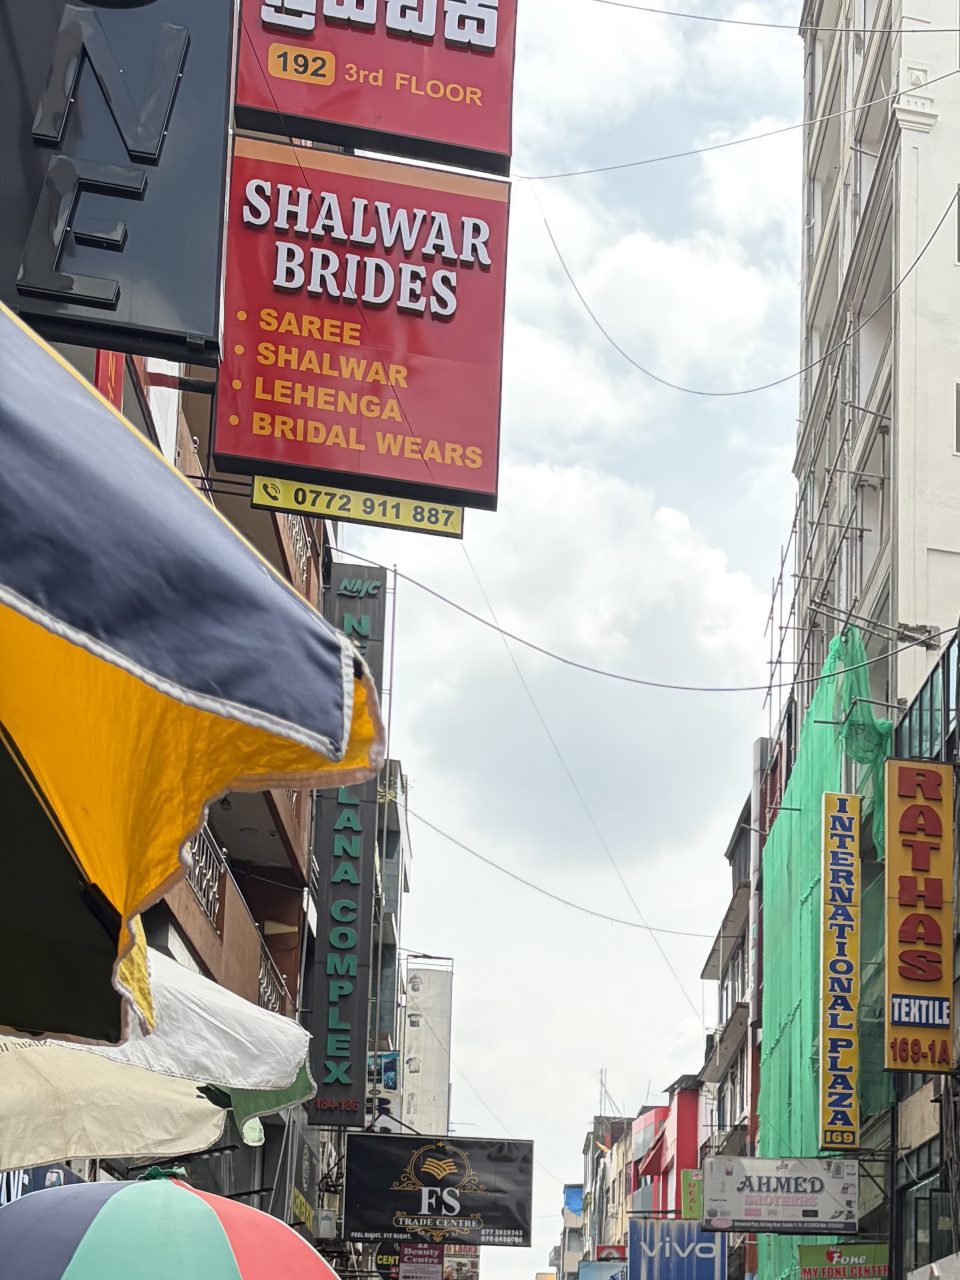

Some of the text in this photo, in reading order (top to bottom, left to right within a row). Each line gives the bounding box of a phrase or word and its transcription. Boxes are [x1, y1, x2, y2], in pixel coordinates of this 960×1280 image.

[277, 51, 482, 106] 192 3rd FLOOR
[242, 179, 493, 269] SHALWAR
[273, 242, 459, 319] BRIDES
[259, 308, 361, 346] SAREE
[256, 343, 408, 388] SHALWAR
[254, 377, 403, 423] LEHENGA
[252, 413, 483, 469] BRIDAL WEARS
[293, 487, 454, 527] 0772 911 887
[337, 578, 382, 597] NMC
[898, 766, 943, 982] RATHAS
[828, 798, 855, 1030] INTERNATIONAL
[323, 899, 358, 1084] COMPLEX
[892, 997, 950, 1026] TEXTILE
[890, 1037, 950, 1065] 169-1A
[827, 1037, 855, 1127] PLAZA
[825, 1131, 854, 1144] 169
[737, 1176, 824, 1193] AHMED
[418, 1186, 460, 1216] FS
[745, 1195, 818, 1206] BROTHERS
[399, 1217, 479, 1228] TRADE CENTRE
[404, 1248, 440, 1257] Beauty
[404, 1256, 439, 1264] Centre
[640, 1237, 716, 1258] vivo
[832, 1253, 866, 1264] Fone
[802, 1264, 888, 1279] MY FONE CENTER
